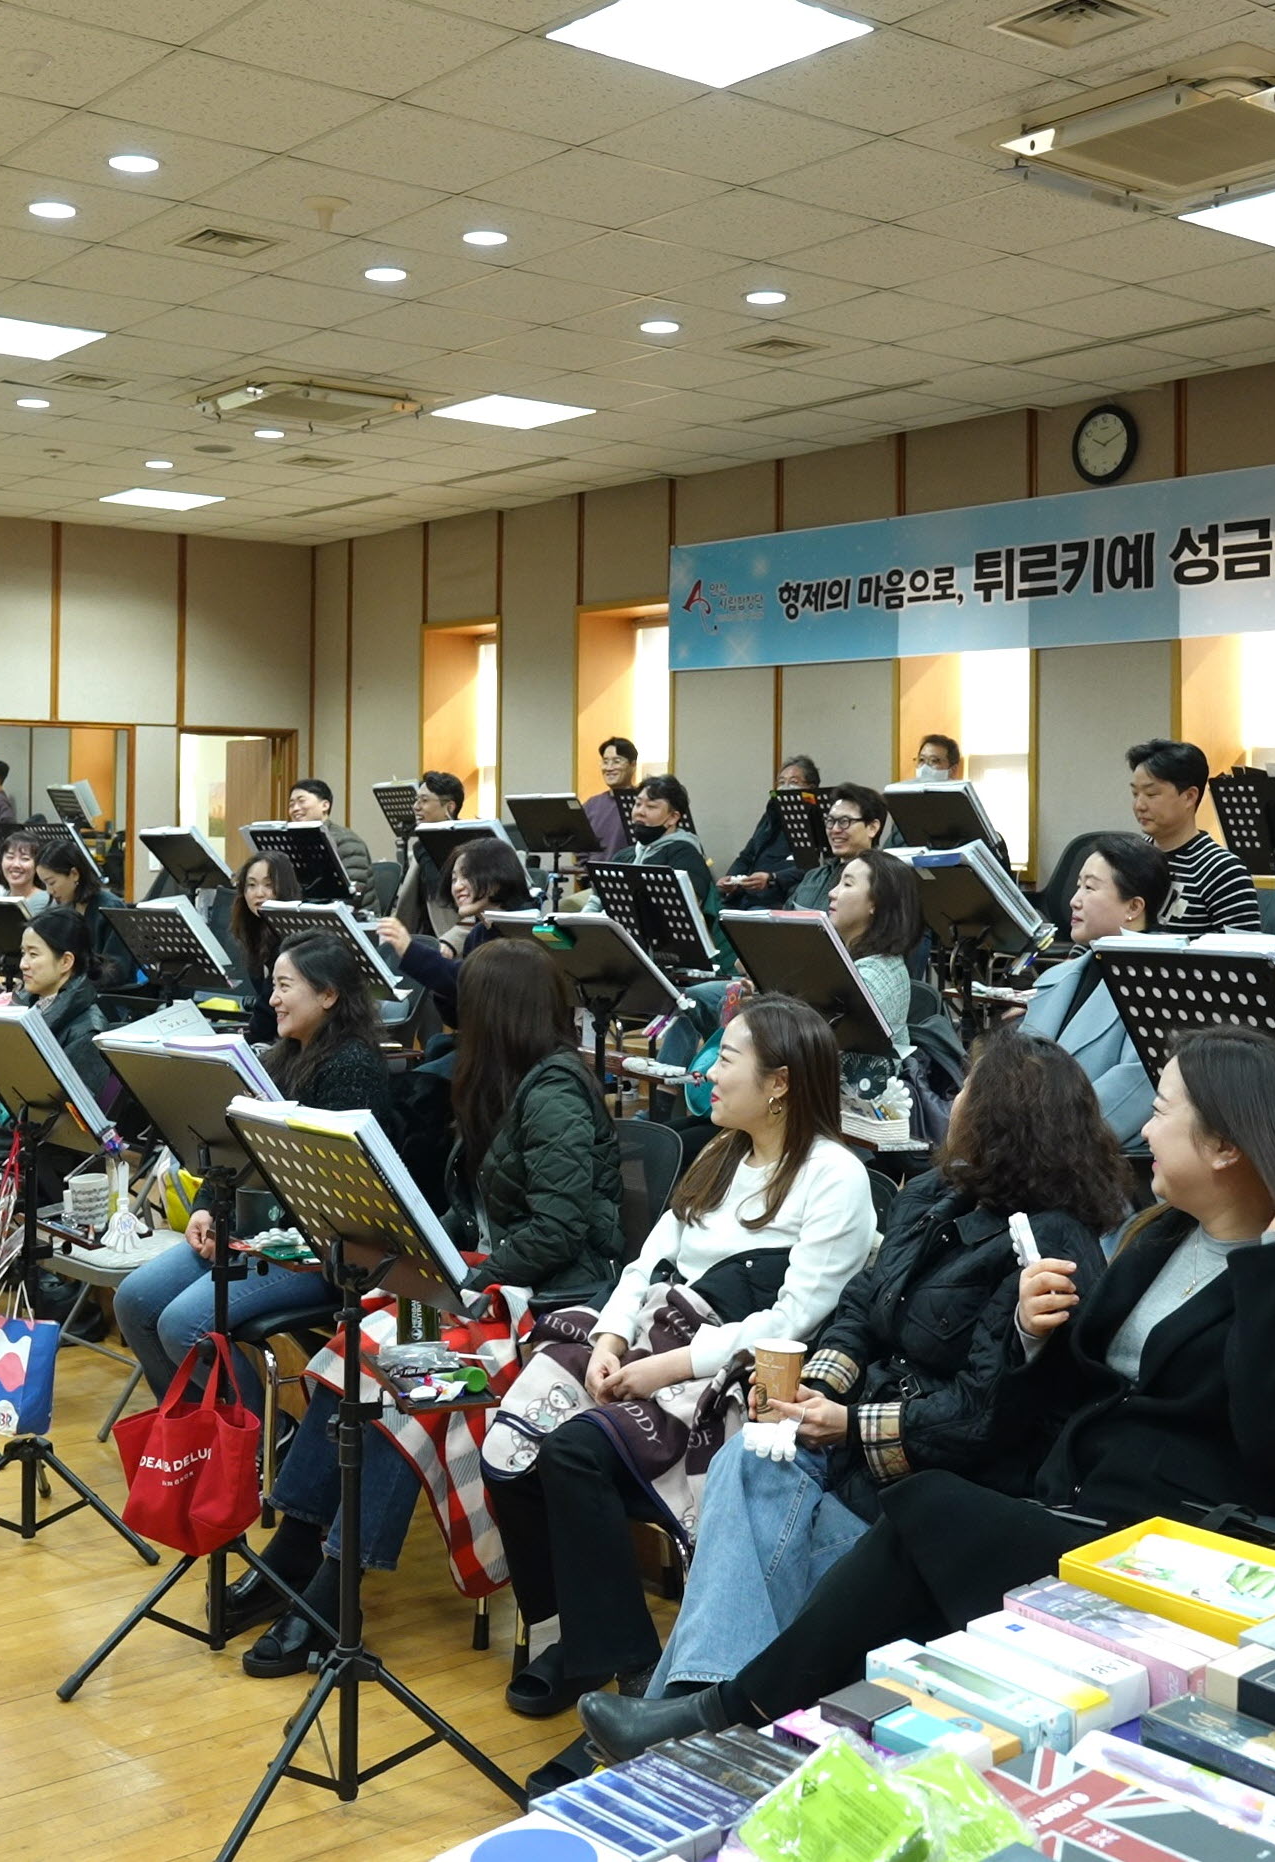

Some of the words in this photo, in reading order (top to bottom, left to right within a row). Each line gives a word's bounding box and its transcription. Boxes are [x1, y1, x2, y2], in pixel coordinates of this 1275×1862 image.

[777, 577, 852, 622] 형제의
[856, 565, 965, 610] 마음으로,
[972, 531, 1156, 602] 튀르키예
